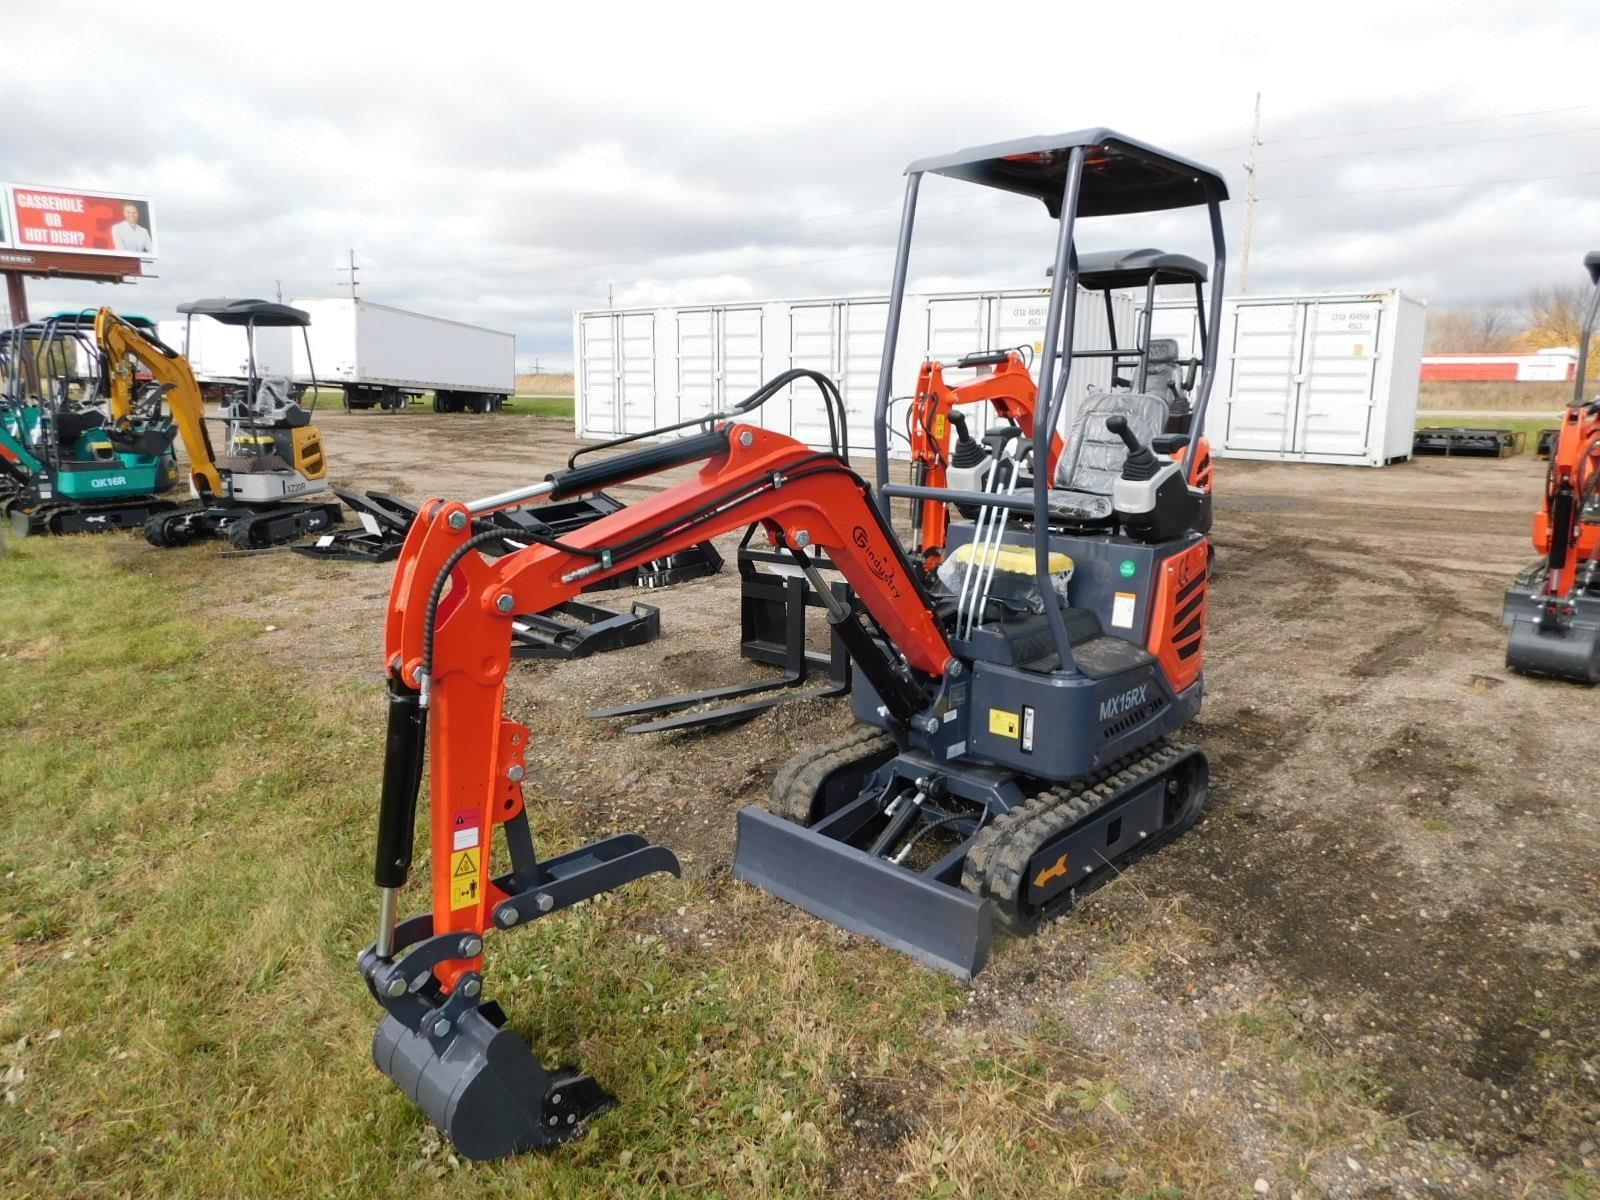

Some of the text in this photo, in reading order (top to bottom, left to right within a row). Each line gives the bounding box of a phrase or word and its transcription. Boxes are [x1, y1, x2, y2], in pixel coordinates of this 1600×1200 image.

[17, 194, 84, 213] CASSEROLE
[45, 213, 63, 227] OR
[24, 228, 85, 245] HOT DISH?
[91, 476, 126, 488] QK16R
[1100, 683, 1148, 722] MX15RX
